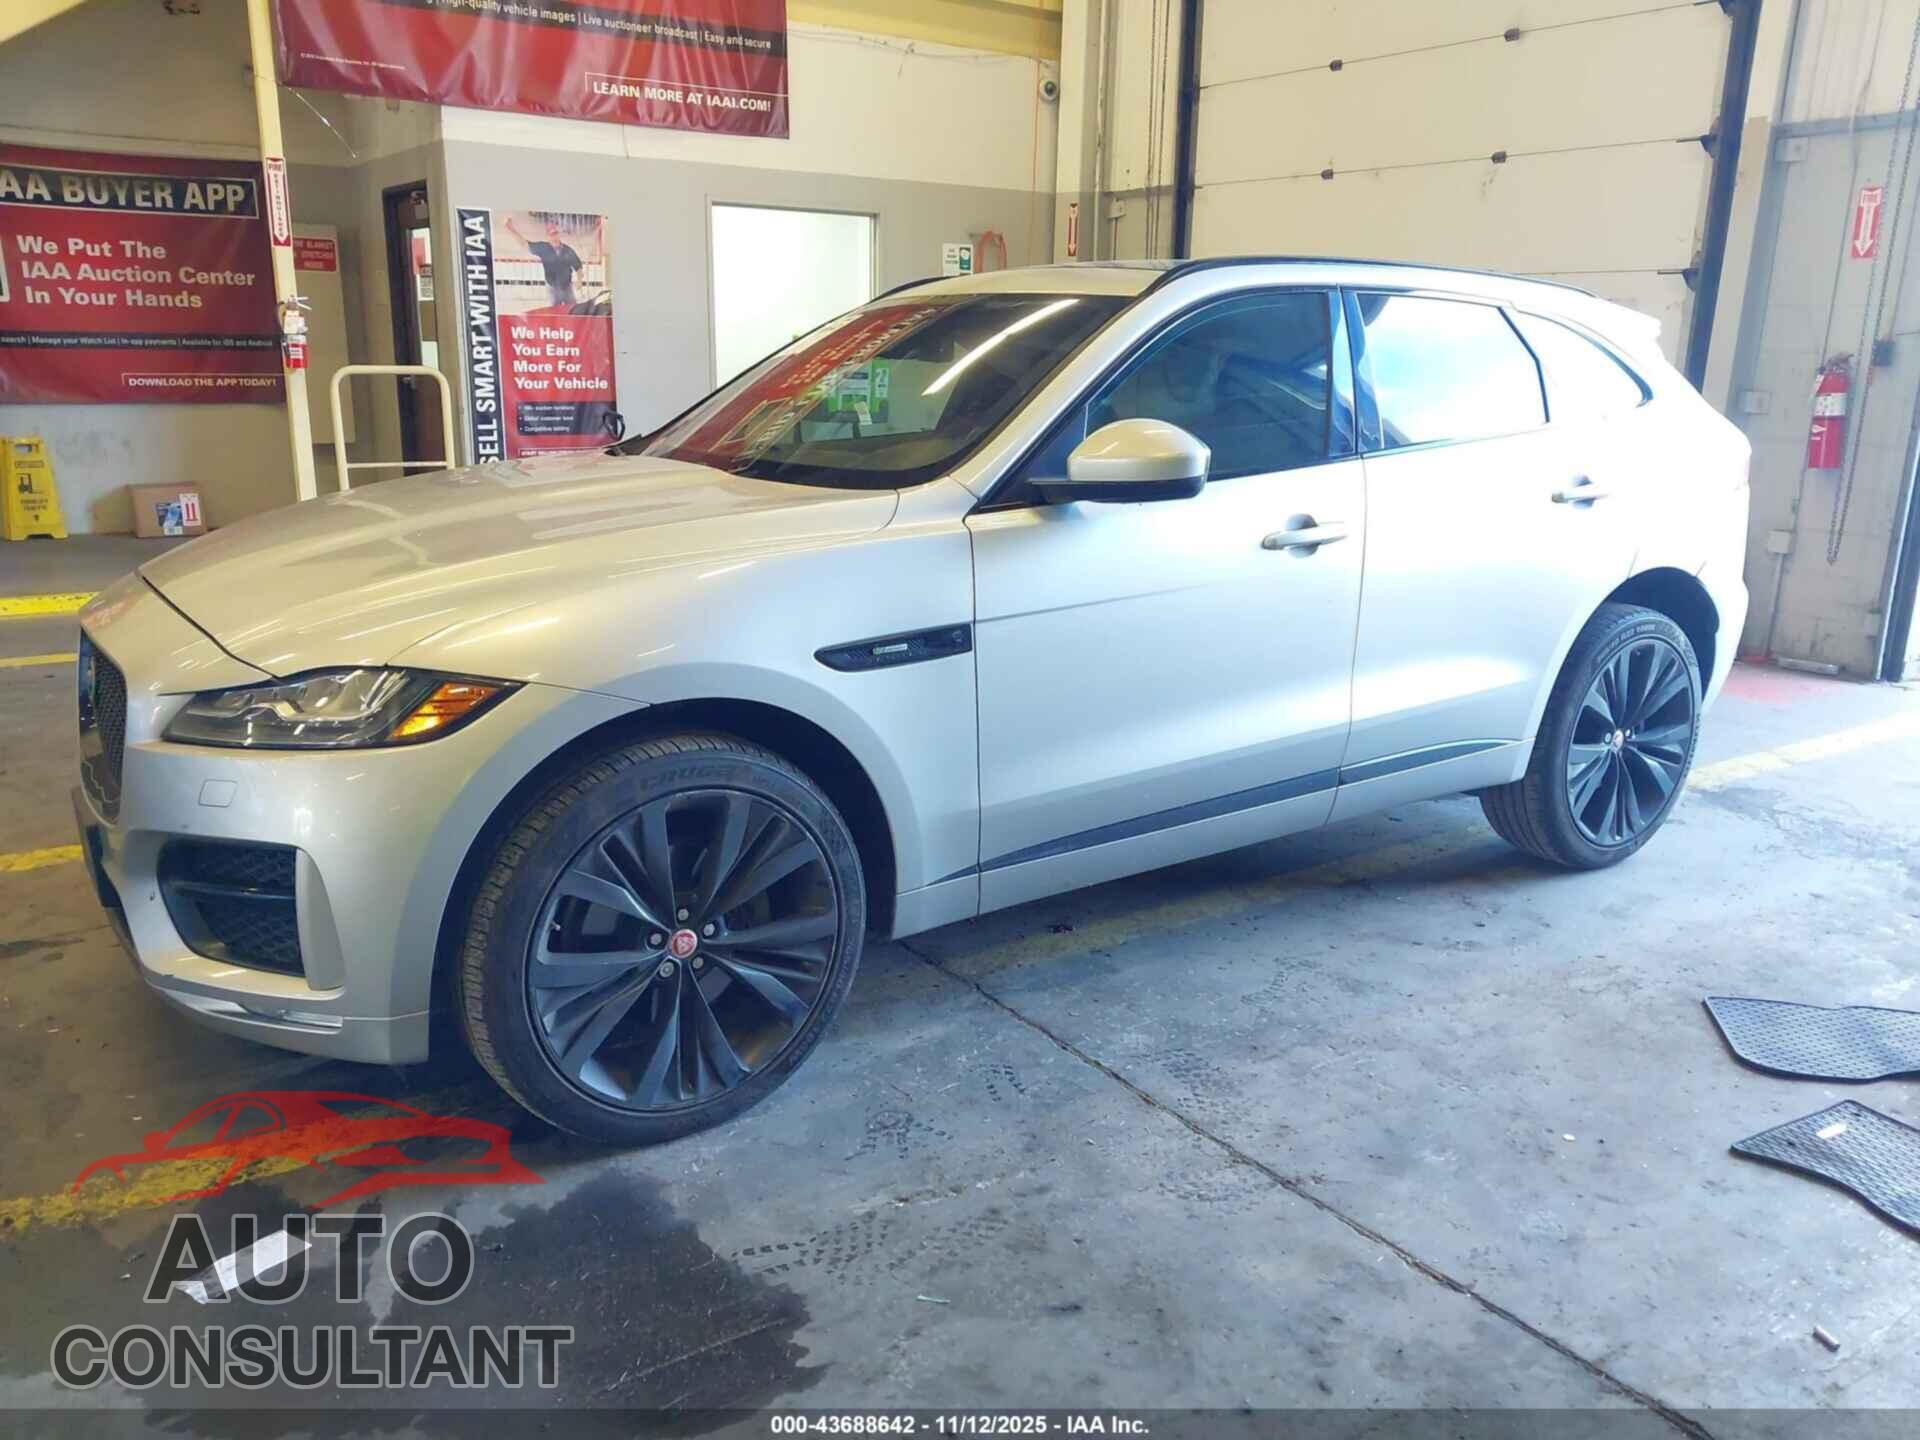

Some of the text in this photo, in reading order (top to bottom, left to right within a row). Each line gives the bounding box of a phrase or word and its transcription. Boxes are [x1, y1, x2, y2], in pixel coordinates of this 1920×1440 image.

[503, 4, 538, 18] vehicle
[540, 11, 576, 24] images
[583, 14, 602, 26] Live
[704, 31, 725, 47] Easy
[593, 80, 772, 113] LEARN MORE AT IAAI.COM!
[61, 175, 174, 208] BUYER
[183, 182, 246, 212] APP
[16, 235, 167, 260] We Put The
[463, 215, 487, 257] IAA
[20, 261, 256, 286] IAA Auction Center
[24, 286, 203, 308] In Your Hands
[466, 264, 491, 326] WITH
[511, 326, 575, 342] We Help
[511, 343, 580, 357] You Earn
[471, 331, 497, 413] SMART
[513, 360, 582, 373] More For
[128, 378, 277, 387] DOWNLOAD THE APP TODAY!
[514, 376, 609, 390] Your Vehicle
